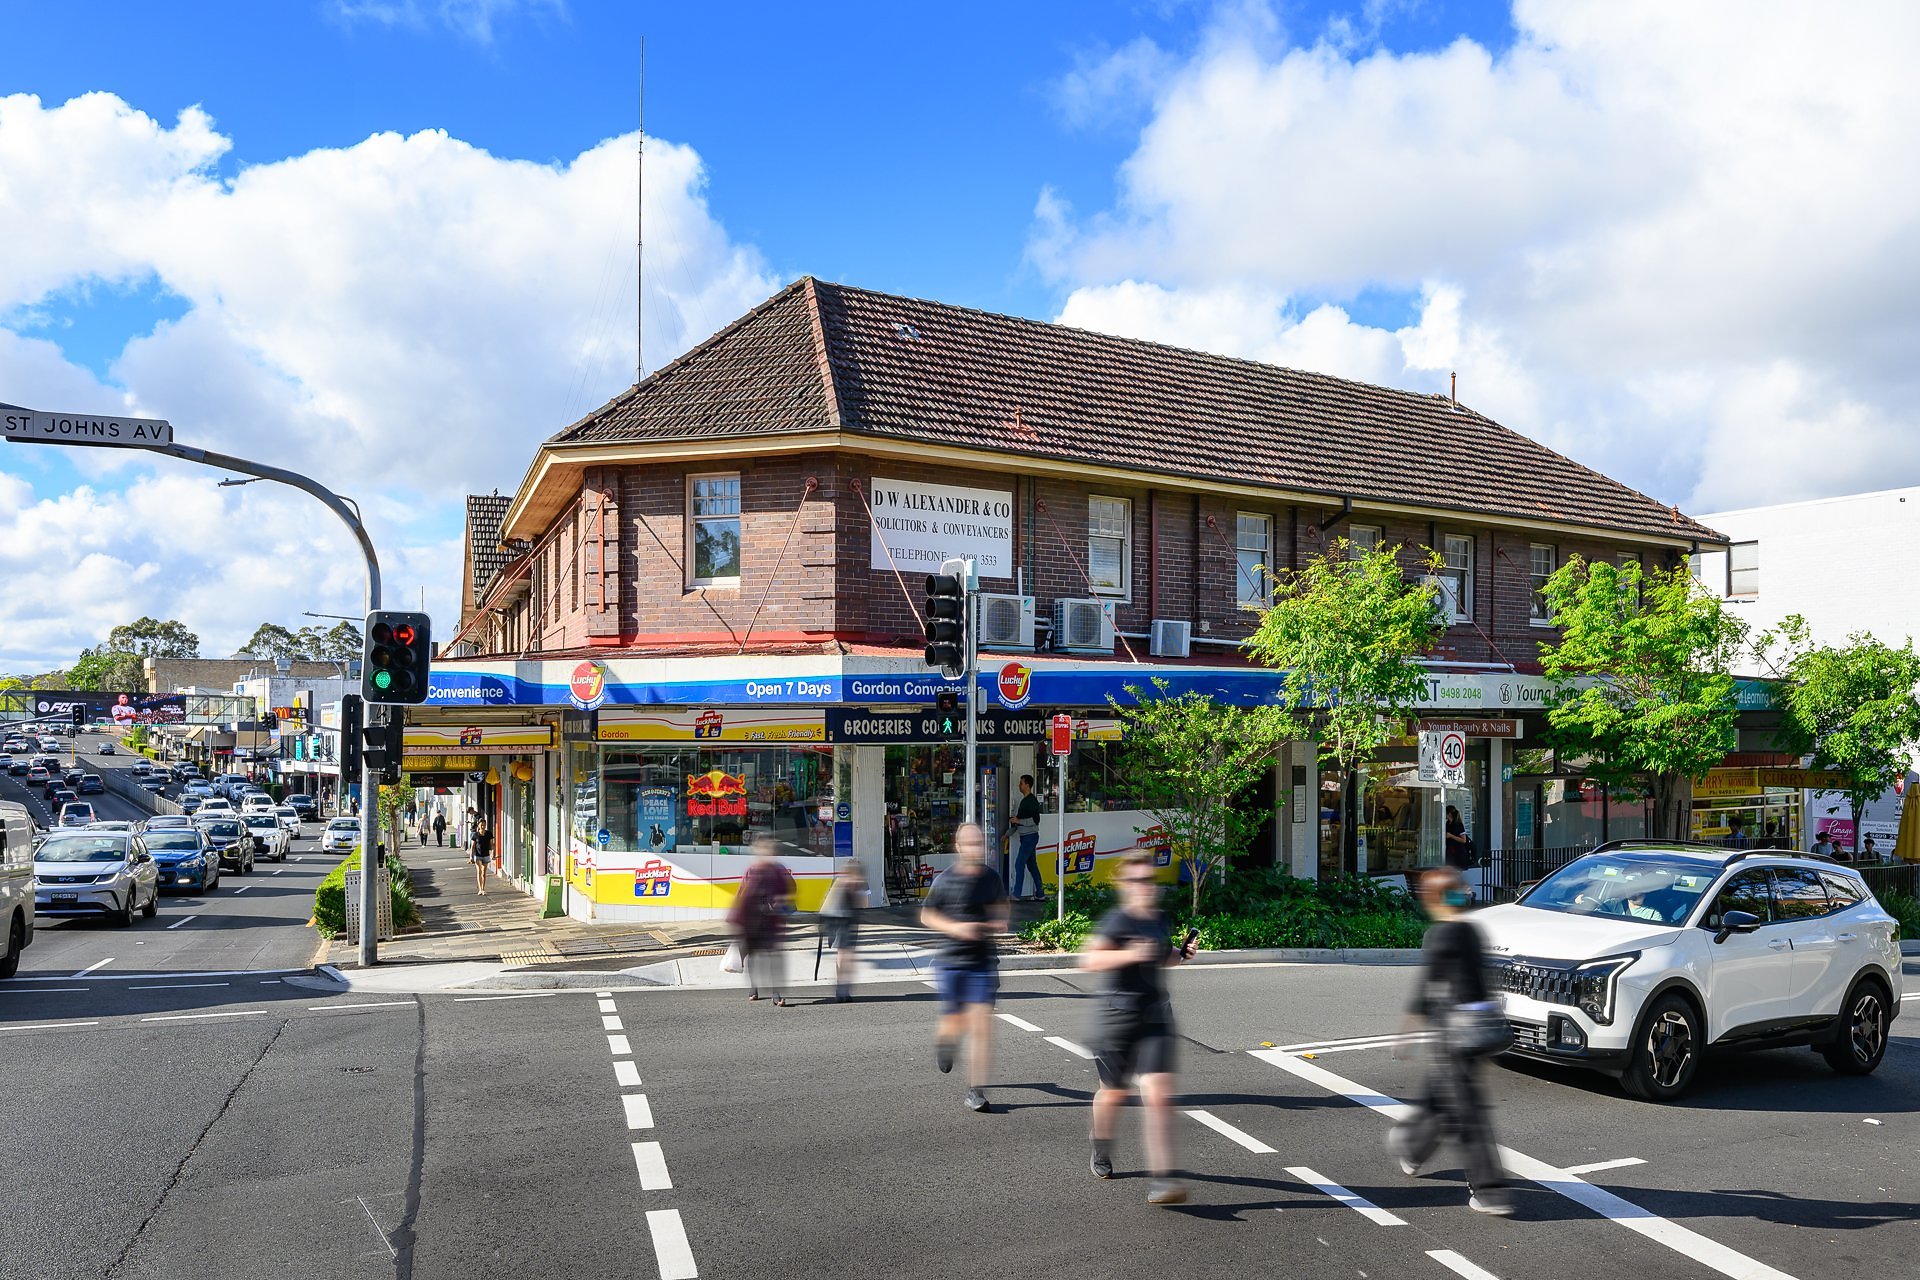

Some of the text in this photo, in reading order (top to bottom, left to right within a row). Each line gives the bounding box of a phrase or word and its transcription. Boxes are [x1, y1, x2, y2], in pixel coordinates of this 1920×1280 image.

[5, 416, 163, 440] ST JOHNS AV
[874, 490, 1010, 518] D W ALEXANDER & CO
[875, 516, 1009, 540] SOLICITORS & CONVEYANCERS
[980, 554, 997, 566] 3533
[571, 666, 606, 696] Lucky 7
[851, 680, 900, 695] Gordon
[1000, 667, 1031, 696] Lucky 7
[428, 684, 504, 699] Convenience
[746, 681, 832, 698] Open 7 Days
[1440, 687, 1460, 699] 9498
[1462, 688, 1482, 699] 2048
[696, 717, 722, 725] LuckMart
[843, 719, 912, 735] GROCERIES
[1453, 722, 1480, 734] Beauty
[1482, 723, 1489, 732] &
[1490, 722, 1511, 733] Nails
[601, 730, 629, 739] Gordon
[1444, 743, 1462, 760] 40
[402, 755, 441, 767] NTERN
[1442, 768, 1464, 780] AREA
[1502, 767, 1512, 780] 17
[1763, 773, 1807, 785] CURRY
[643, 806, 669, 816] LOVE
[687, 797, 747, 816] Red Bull
[1060, 840, 1093, 854] uckMart
[636, 869, 670, 880] LuckMart
